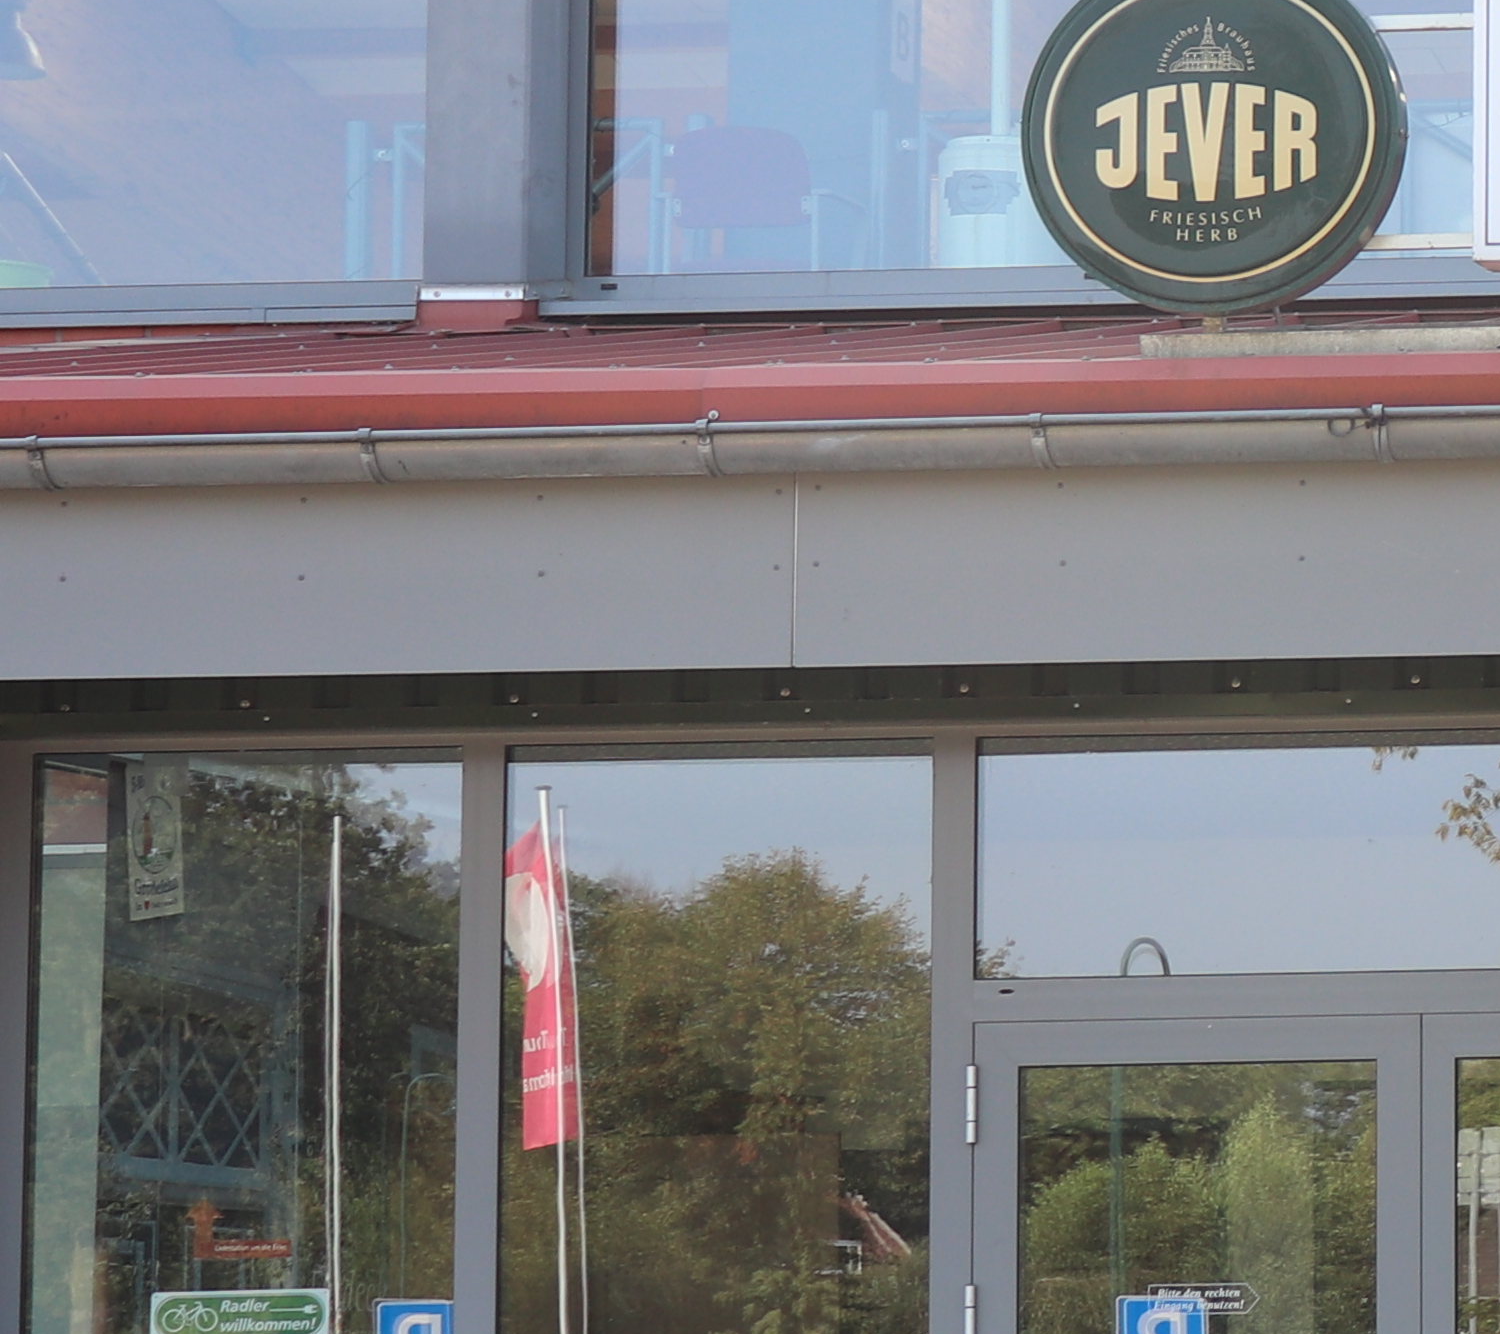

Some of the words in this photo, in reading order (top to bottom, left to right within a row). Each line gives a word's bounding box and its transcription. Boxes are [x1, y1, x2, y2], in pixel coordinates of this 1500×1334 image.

[1155, 23, 1200, 73] Friesisches
[1216, 22, 1256, 71] Brauhaus
[1095, 81, 1318, 202] JEVER
[1149, 206, 1263, 226] FRIESISCH
[1175, 227, 1239, 243] HERB
[1157, 1288, 1182, 1299] Bitte
[1184, 1288, 1201, 1299] den
[1204, 1287, 1241, 1299] rechten
[219, 1298, 271, 1314] Radler
[1154, 1300, 1194, 1312] Eingang
[1197, 1299, 1245, 1310] benutzen!
[219, 1317, 317, 1333] willkommen!
